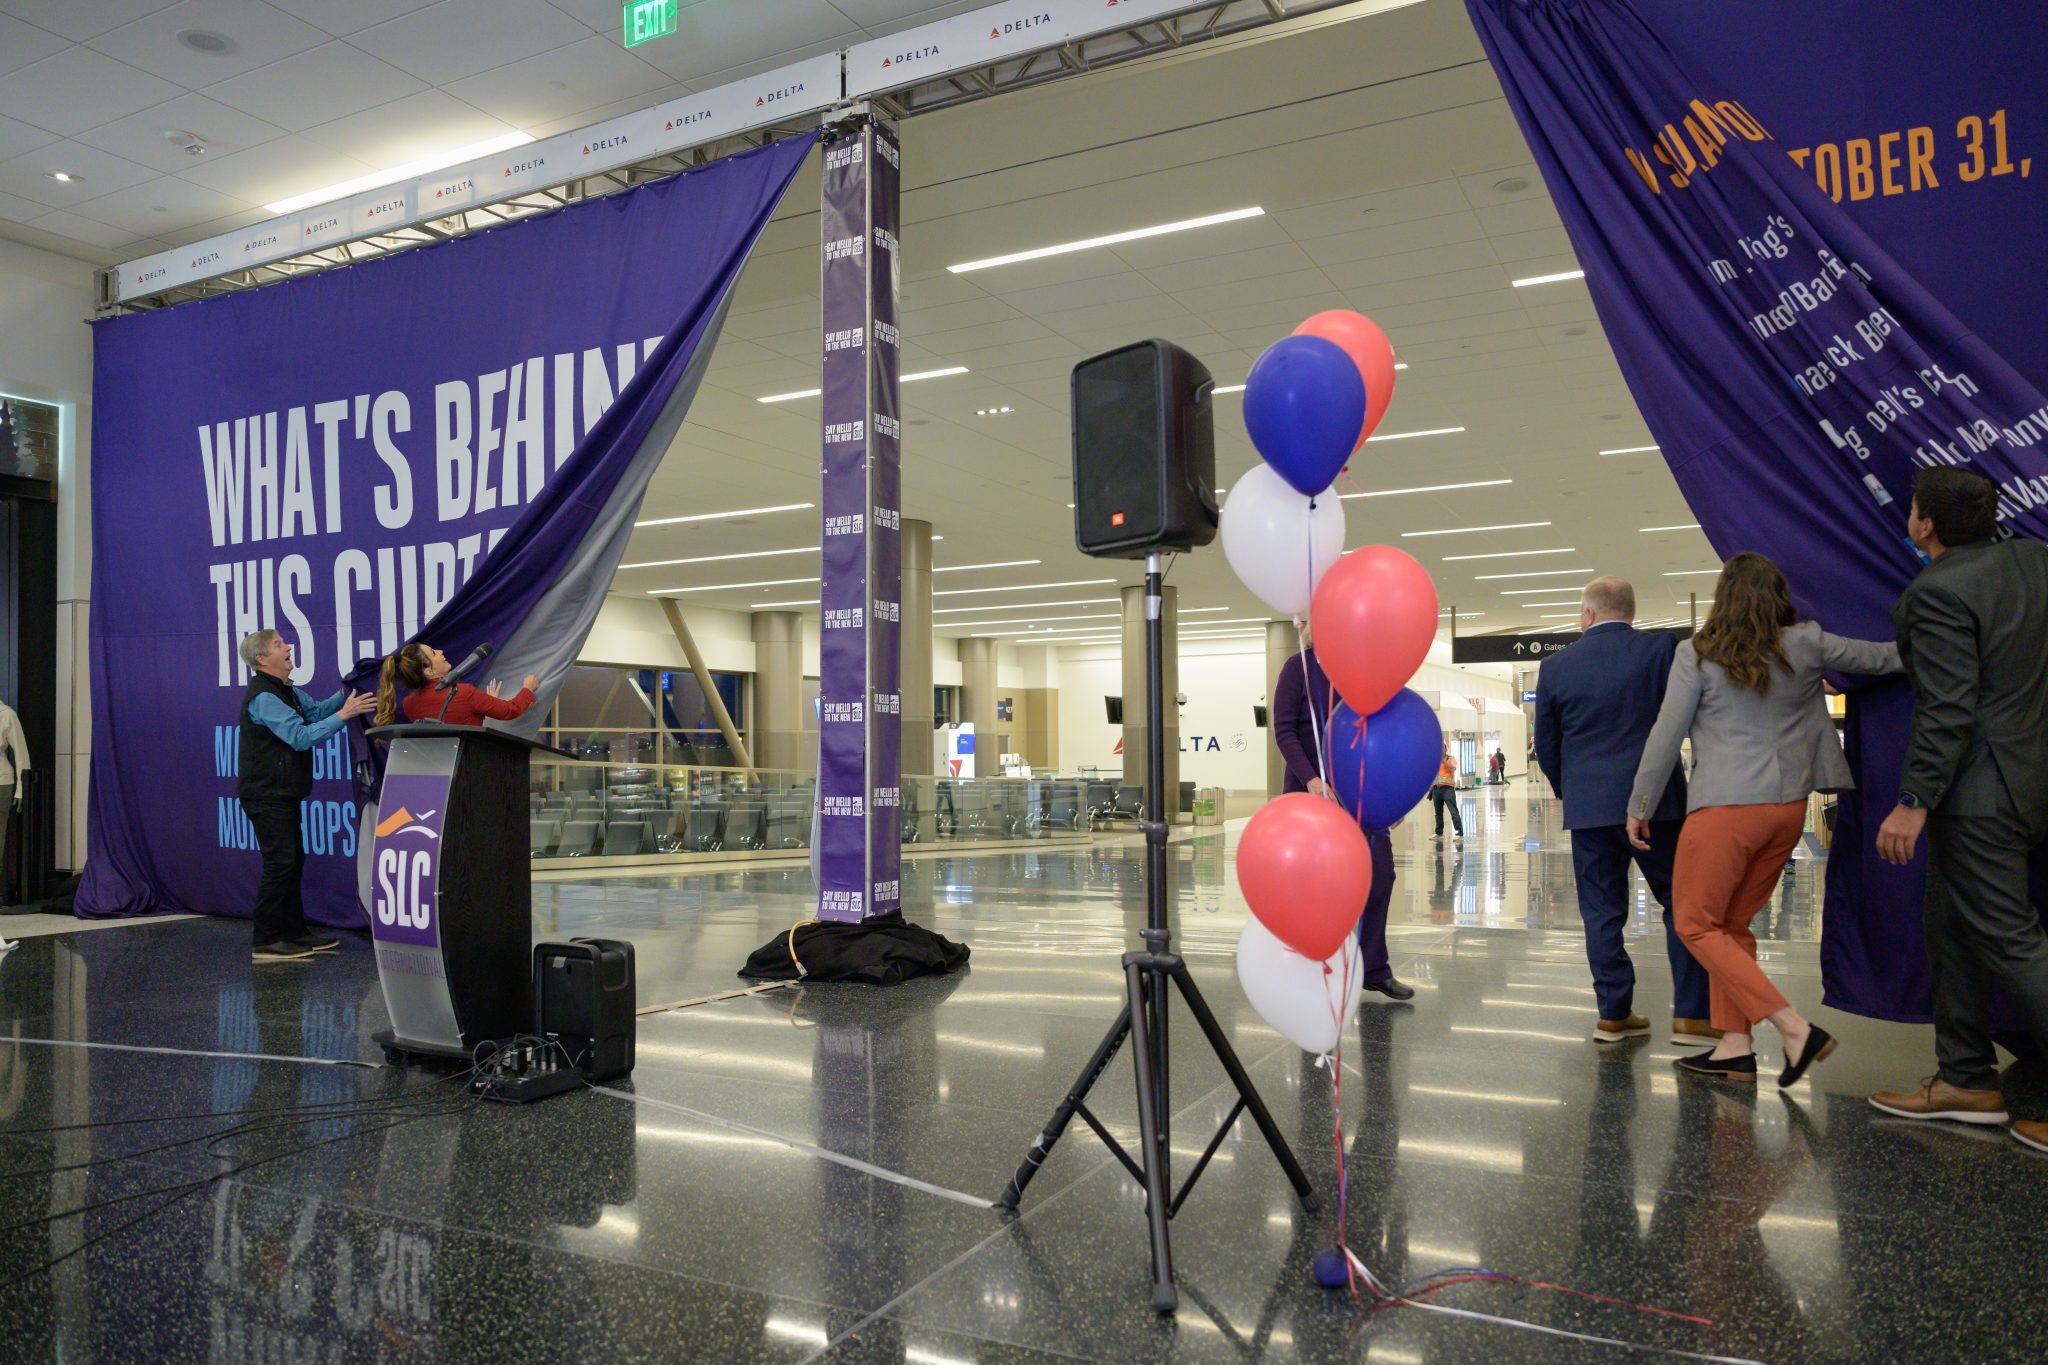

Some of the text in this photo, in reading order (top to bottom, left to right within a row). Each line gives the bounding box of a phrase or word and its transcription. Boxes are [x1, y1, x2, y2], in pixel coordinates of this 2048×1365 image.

[634, 0, 668, 41] EXIT
[1004, 13, 1051, 34] DELTA
[895, 45, 940, 64] DELTA
[767, 83, 804, 102] DELTA
[676, 110, 712, 127] DELTA
[592, 135, 628, 152] DELTA
[1956, 109, 2032, 182] 31,
[827, 146, 851, 161] SAY HELLO
[513, 158, 545, 174] DELTA
[445, 180, 473, 195] DELTA
[376, 200, 404, 214] DELTA
[313, 219, 338, 232] DELTA
[252, 236, 277, 248] DELTA
[826, 238, 852, 252] SAY HELLO
[198, 253, 219, 265] DELTA
[145, 268, 166, 281] DELTA
[826, 330, 851, 343] SAY HELLO
[826, 423, 852, 435] SAY HELLO
[199, 335, 664, 547] WHAT'S BEHIN
[826, 516, 851, 527] SAY HELLO
[209, 554, 315, 687] THIS
[825, 609, 851, 620] SAY HELLO
[825, 703, 850, 713] SAY HELLO
[1179, 736, 1221, 752] LTA
[825, 797, 851, 806] SAY HELLO
[377, 848, 431, 930] SLC
[823, 891, 849, 901] SAY HELLO
